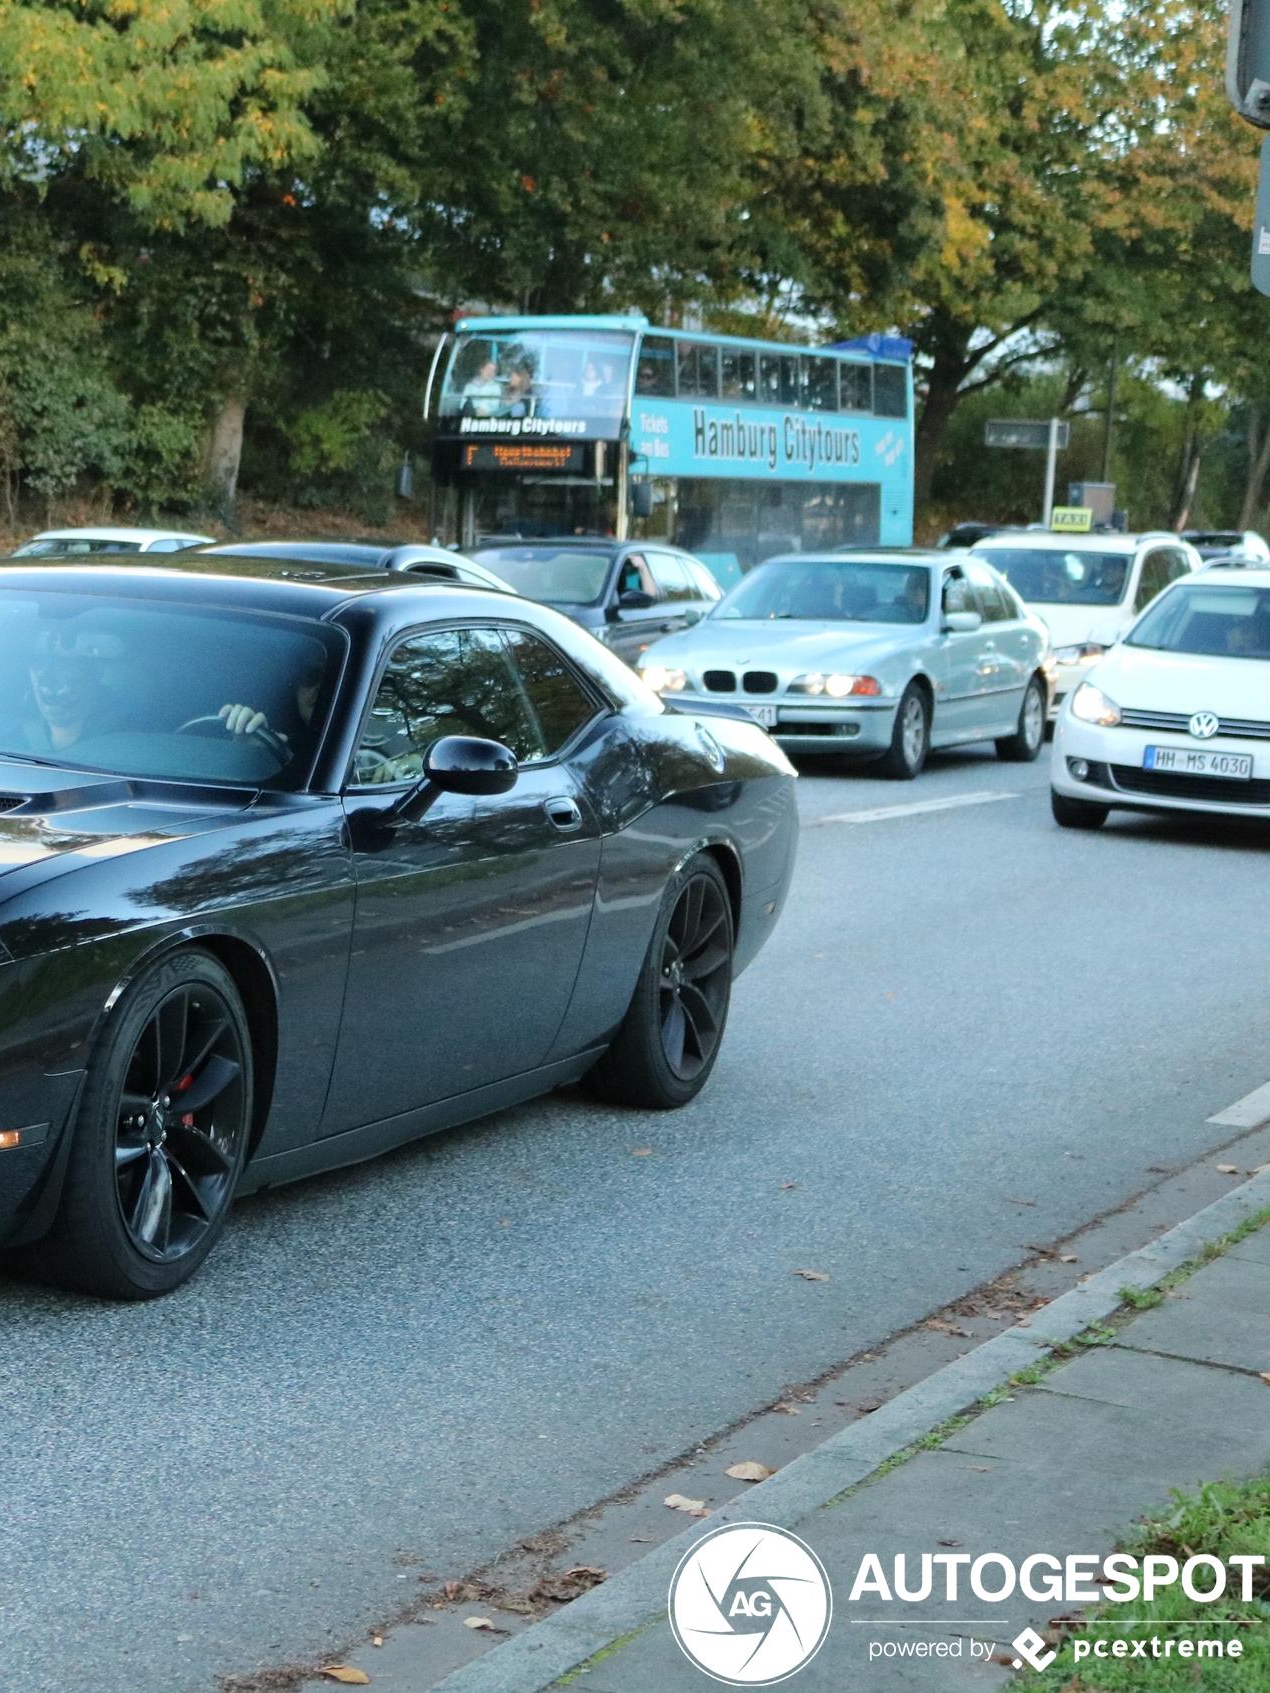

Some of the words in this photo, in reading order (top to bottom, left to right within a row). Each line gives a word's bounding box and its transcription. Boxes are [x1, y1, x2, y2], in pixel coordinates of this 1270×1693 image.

[460, 416, 521, 436] Hamburg
[522, 416, 586, 436] Citytours
[640, 413, 668, 434] Tickets
[693, 408, 777, 472] Hamburg
[784, 415, 860, 473] Citytours
[1055, 513, 1088, 525] TAXI
[1156, 751, 1176, 767] HH
[1187, 755, 1206, 771] MS
[1211, 757, 1249, 775] 4030
